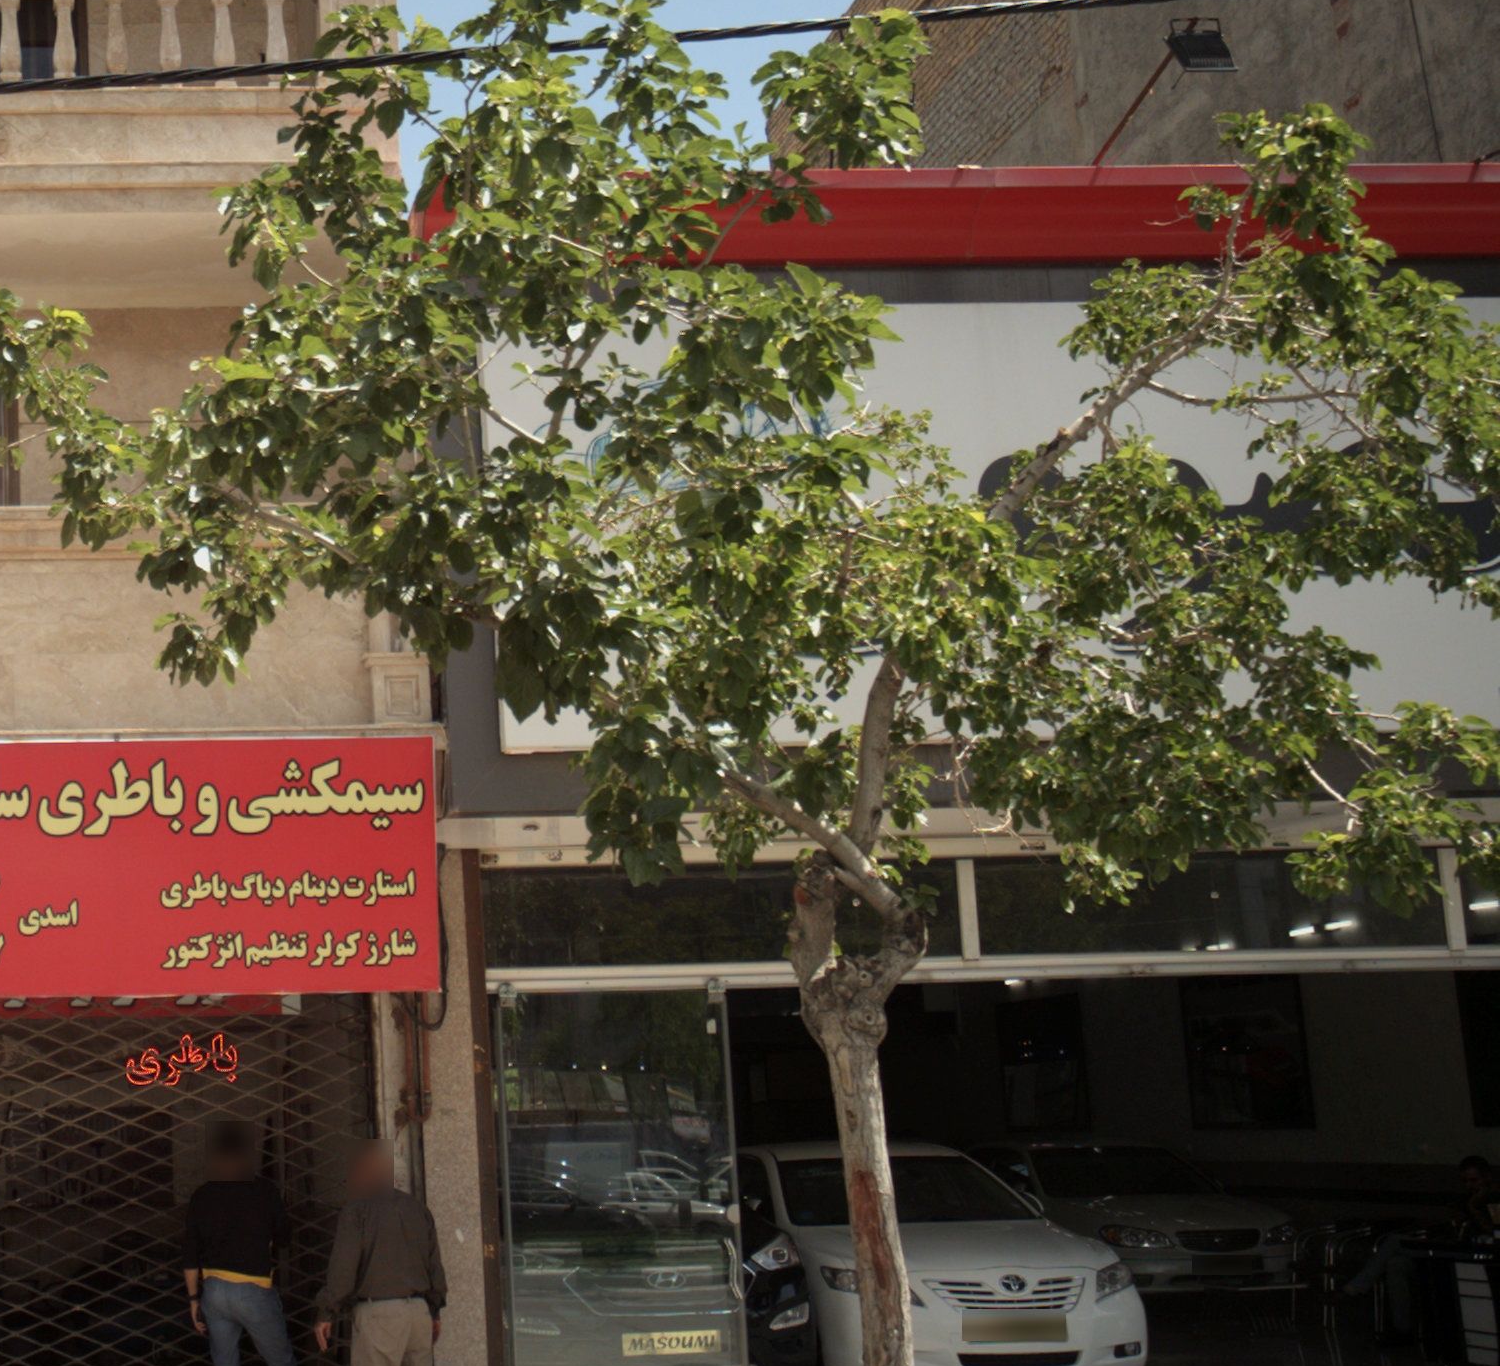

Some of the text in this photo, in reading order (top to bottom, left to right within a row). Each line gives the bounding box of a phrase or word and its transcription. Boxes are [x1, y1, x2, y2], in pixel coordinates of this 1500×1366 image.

[37, 759, 185, 837] باطری
[191, 784, 220, 835] و
[227, 759, 425, 834] سیمکشی
[160, 870, 416, 909] استارت دینام دیاگ باطری
[18, 900, 79, 936] اسدی
[244, 931, 308, 967] تنظیم
[309, 931, 362, 967] کولر
[364, 930, 417, 966] شارژ
[628, 1335, 716, 1351] MASOUMI
